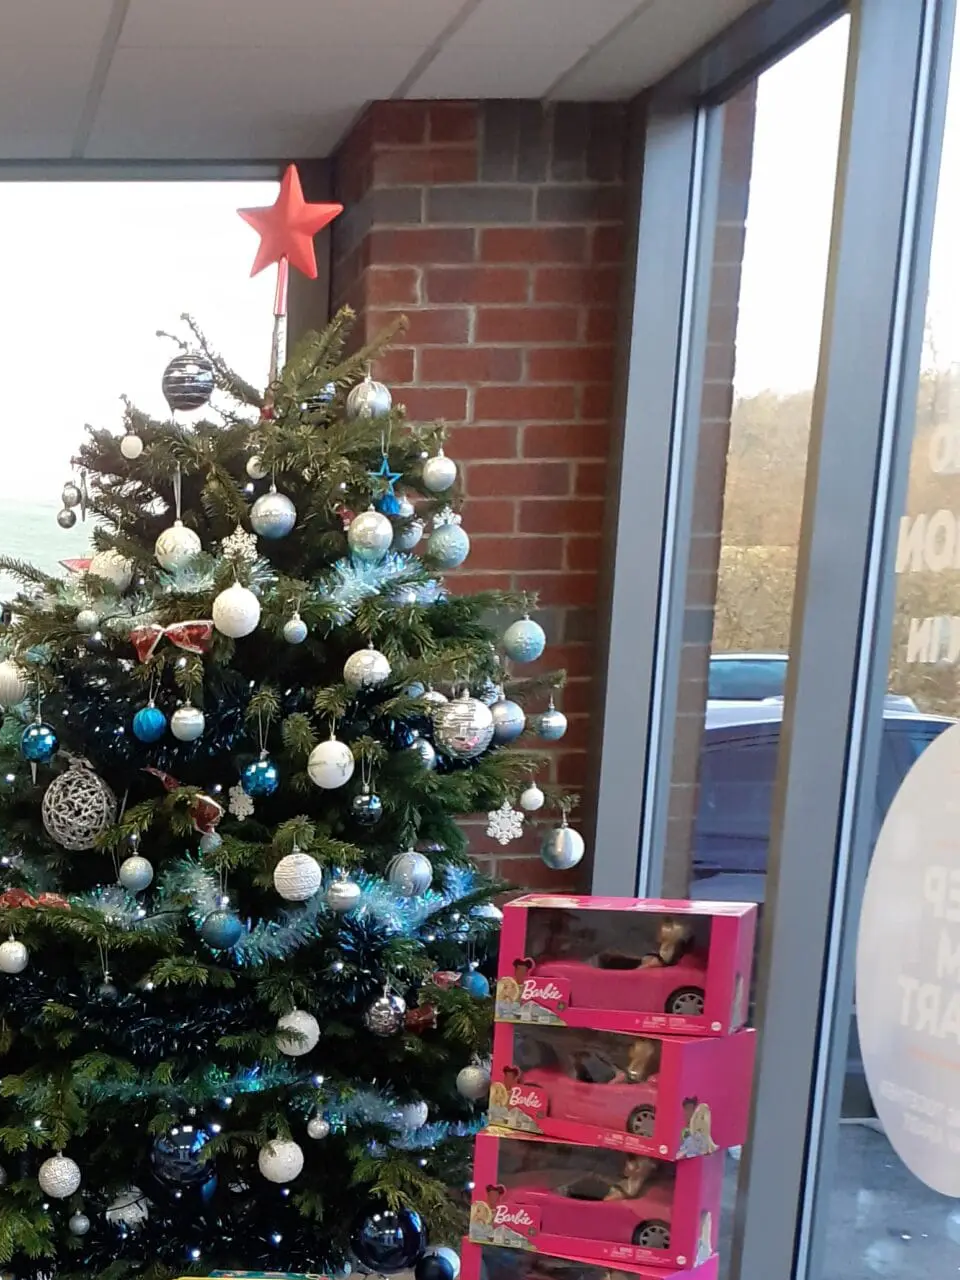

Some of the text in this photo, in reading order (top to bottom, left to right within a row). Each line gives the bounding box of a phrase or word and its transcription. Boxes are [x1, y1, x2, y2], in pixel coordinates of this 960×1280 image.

[521, 979, 562, 1001] Barbie
[509, 1086, 542, 1109] Barbie
[494, 1205, 534, 1226] Barbie
